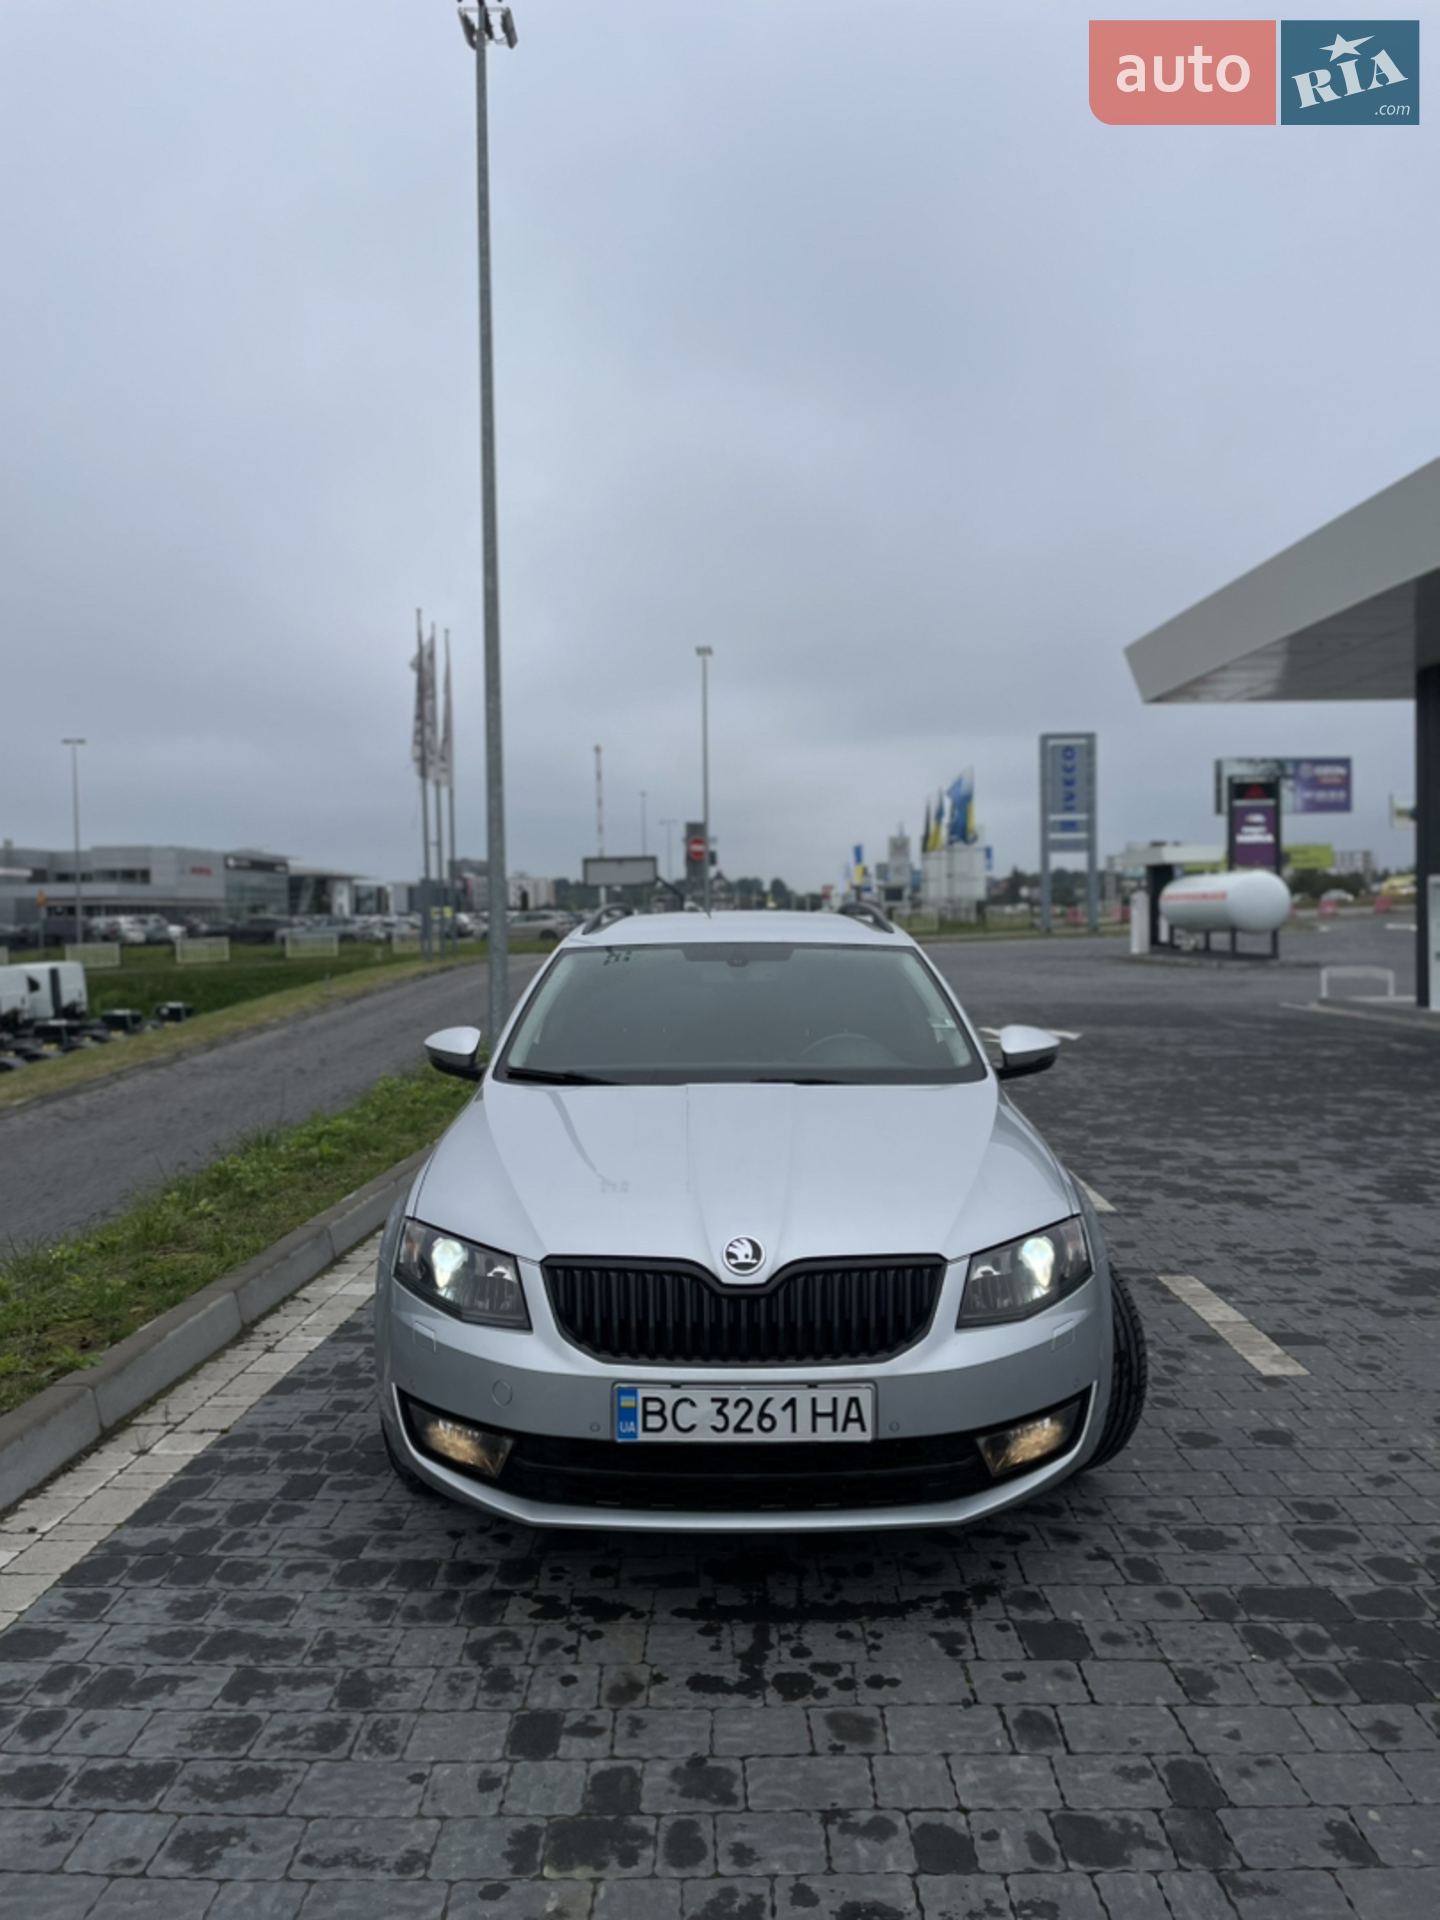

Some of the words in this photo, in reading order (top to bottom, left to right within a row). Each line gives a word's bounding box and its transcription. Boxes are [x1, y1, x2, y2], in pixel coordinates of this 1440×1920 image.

[1062, 746, 1076, 812] IVECO
[619, 1421, 636, 1433] UA
[641, 1397, 697, 1433] BC
[710, 1397, 798, 1434] 3261
[811, 1397, 866, 1433] HA
